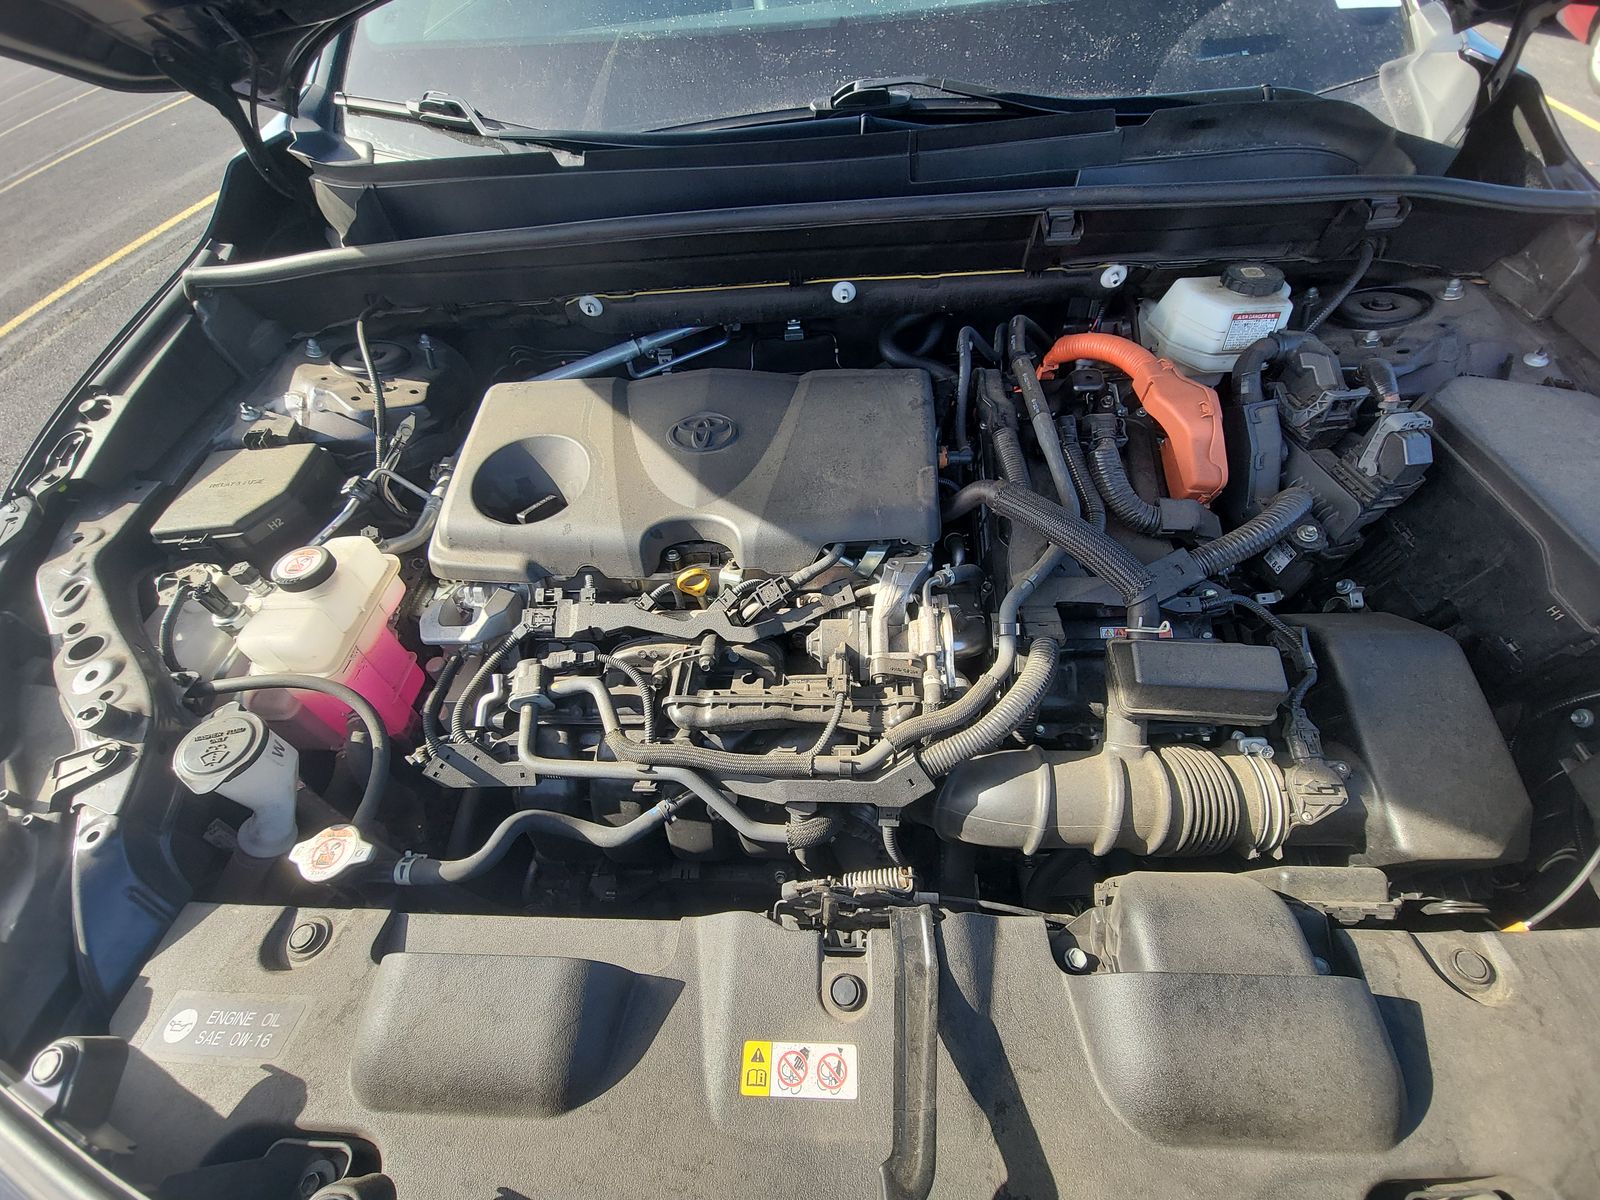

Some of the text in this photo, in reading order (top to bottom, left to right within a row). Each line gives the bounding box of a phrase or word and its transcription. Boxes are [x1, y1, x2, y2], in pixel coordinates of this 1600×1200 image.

[267, 518, 285, 531] H2
[1546, 605, 1565, 621] H1
[206, 1010, 281, 1028] ENGINE OIL
[195, 1030, 273, 1048] SAE 0W-16
